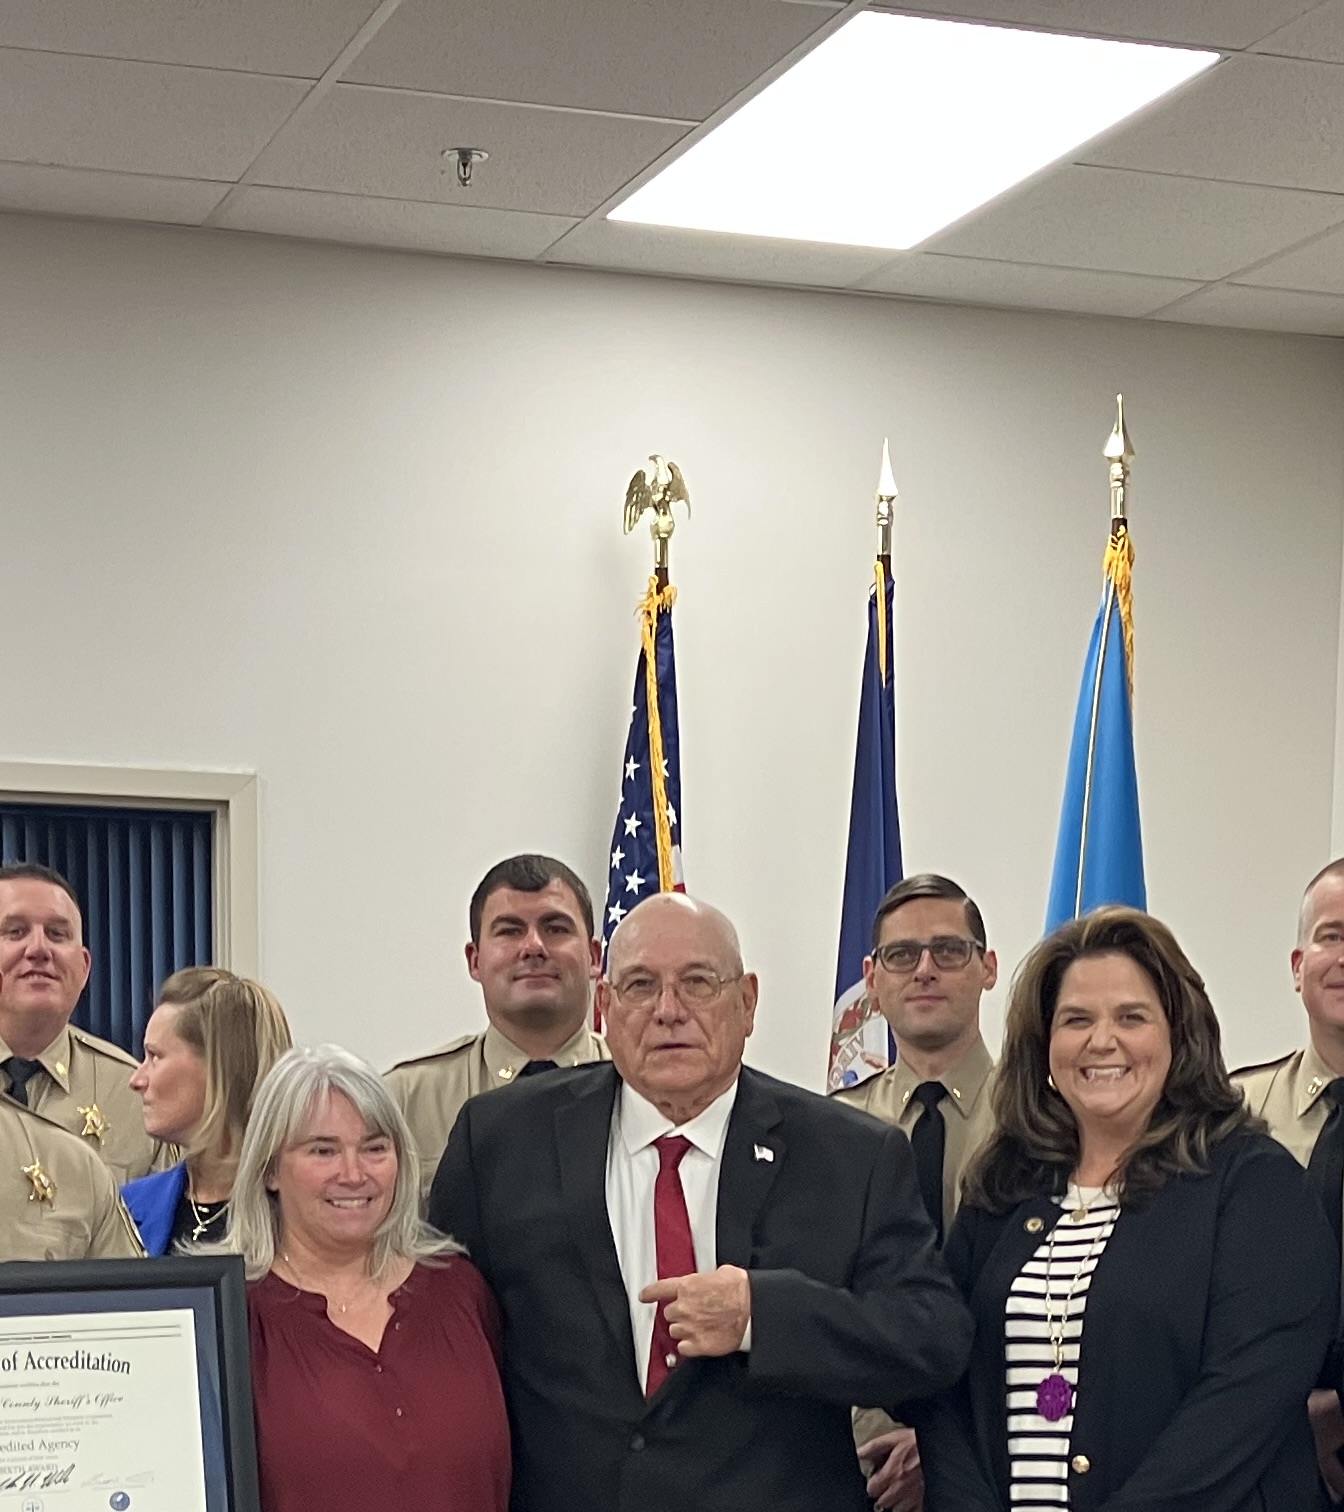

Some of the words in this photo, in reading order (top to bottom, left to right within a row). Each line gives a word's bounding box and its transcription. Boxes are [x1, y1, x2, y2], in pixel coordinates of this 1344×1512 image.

[1, 1350, 19, 1372] of
[24, 1350, 131, 1375] Accreditation
[1, 1397, 41, 1411] County
[45, 1393, 91, 1409] Sheriff's
[94, 1392, 124, 1408] Office
[39, 1439, 80, 1453] Agency
